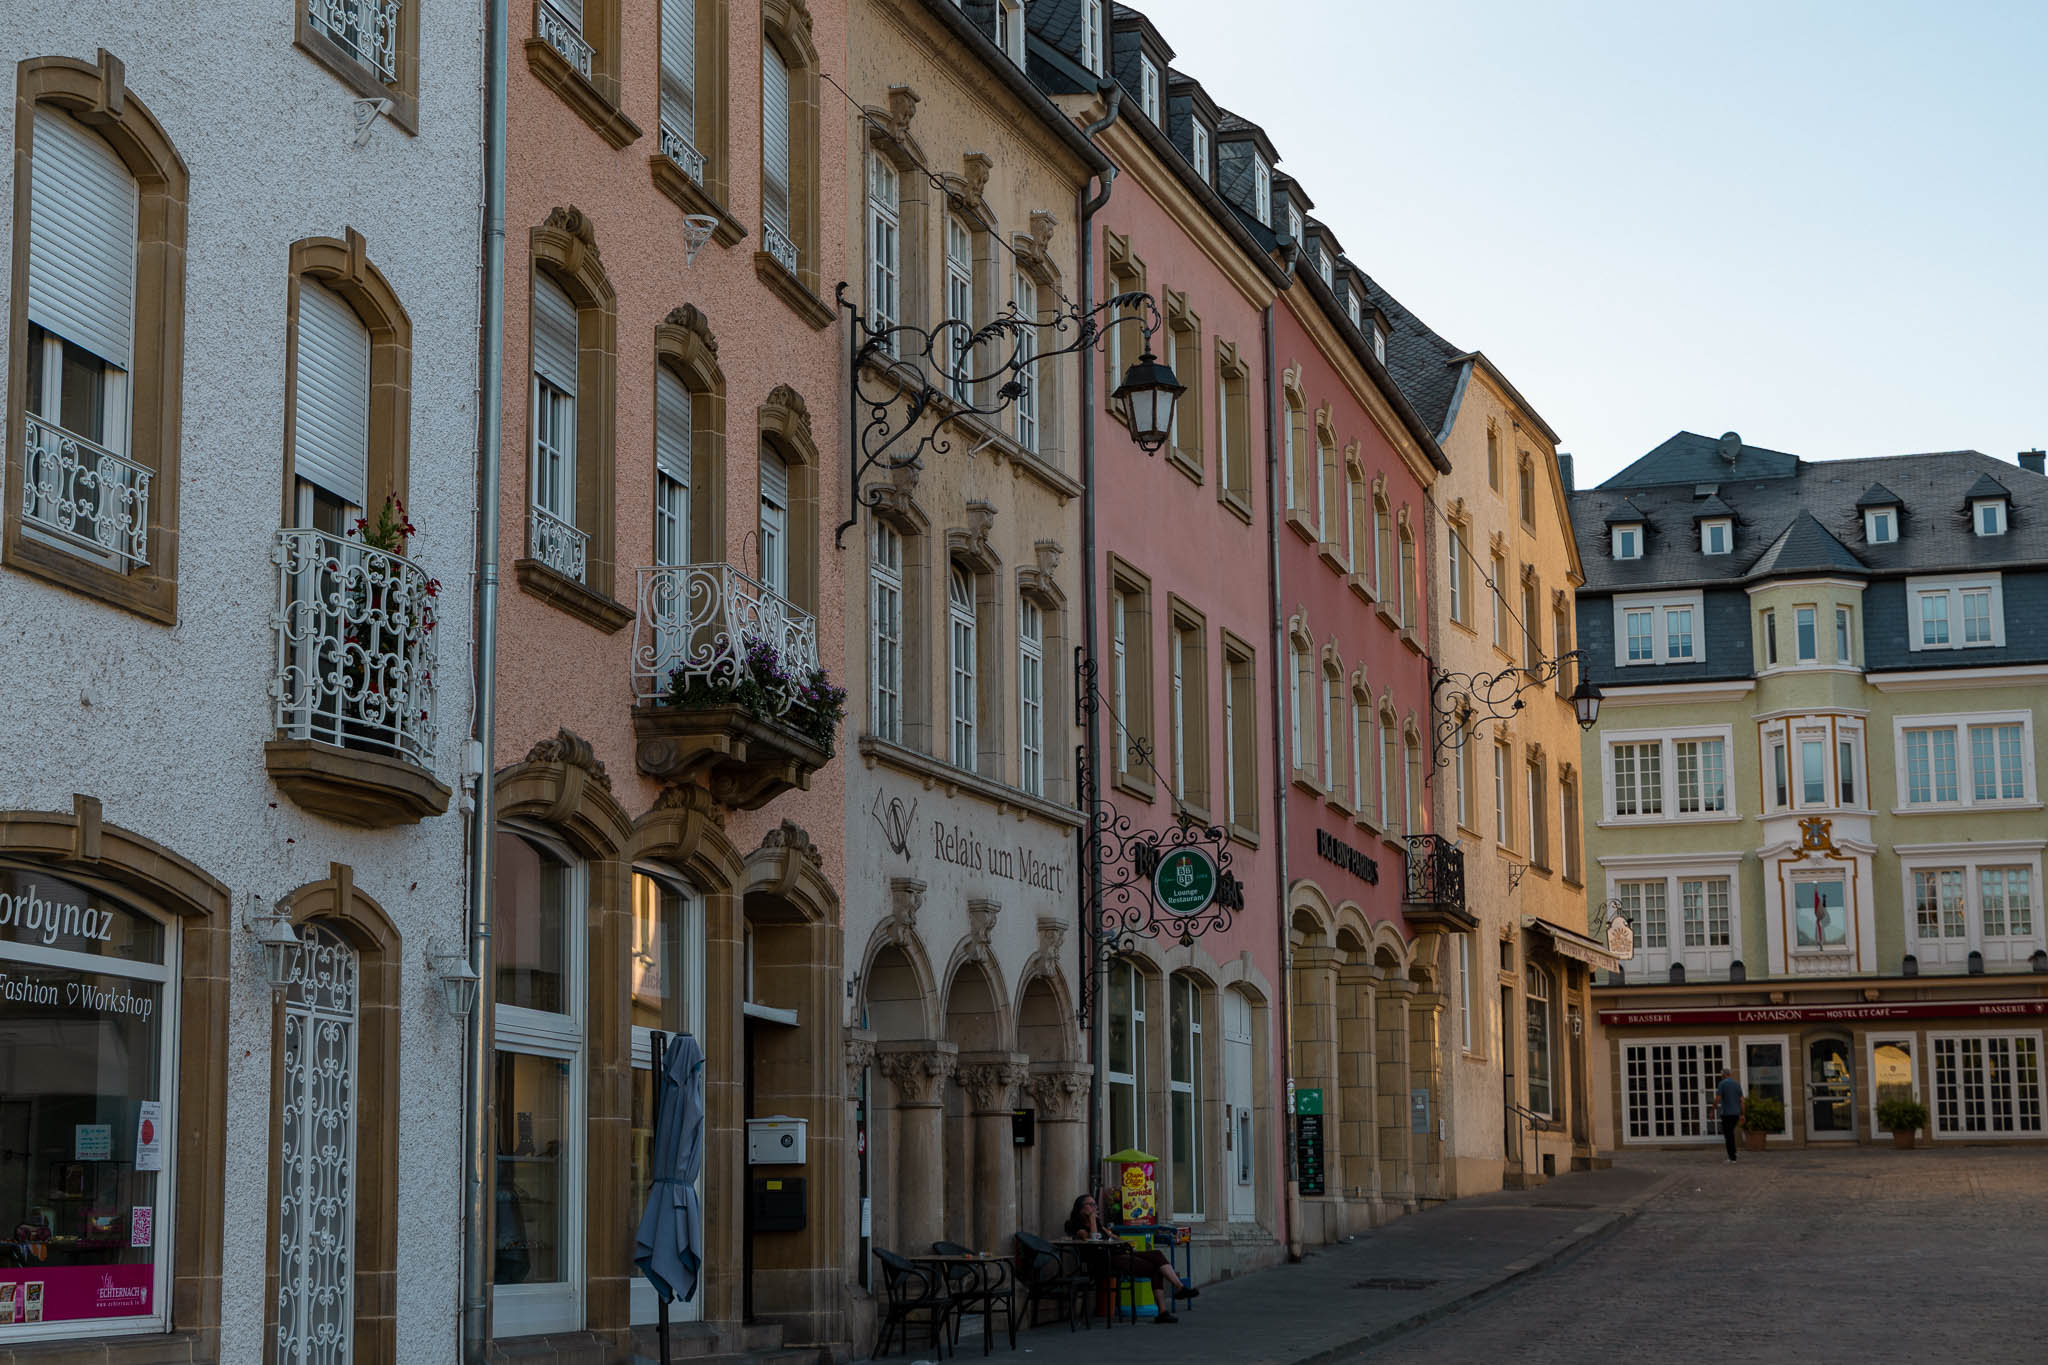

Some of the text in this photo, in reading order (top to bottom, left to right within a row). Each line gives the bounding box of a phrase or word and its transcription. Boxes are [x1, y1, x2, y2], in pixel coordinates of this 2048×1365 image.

[934, 821, 1063, 894] Relais um Maart
[1173, 889, 1199, 897] Lounge
[1167, 895, 1205, 905] Restaurant
[81, 983, 153, 1023] Workshop
[1979, 1003, 2026, 1015] BRASSERIE
[1826, 1006, 1890, 1018] HOSTEL ET CAFÉ
[1628, 1014, 1672, 1024] BRASSERIE
